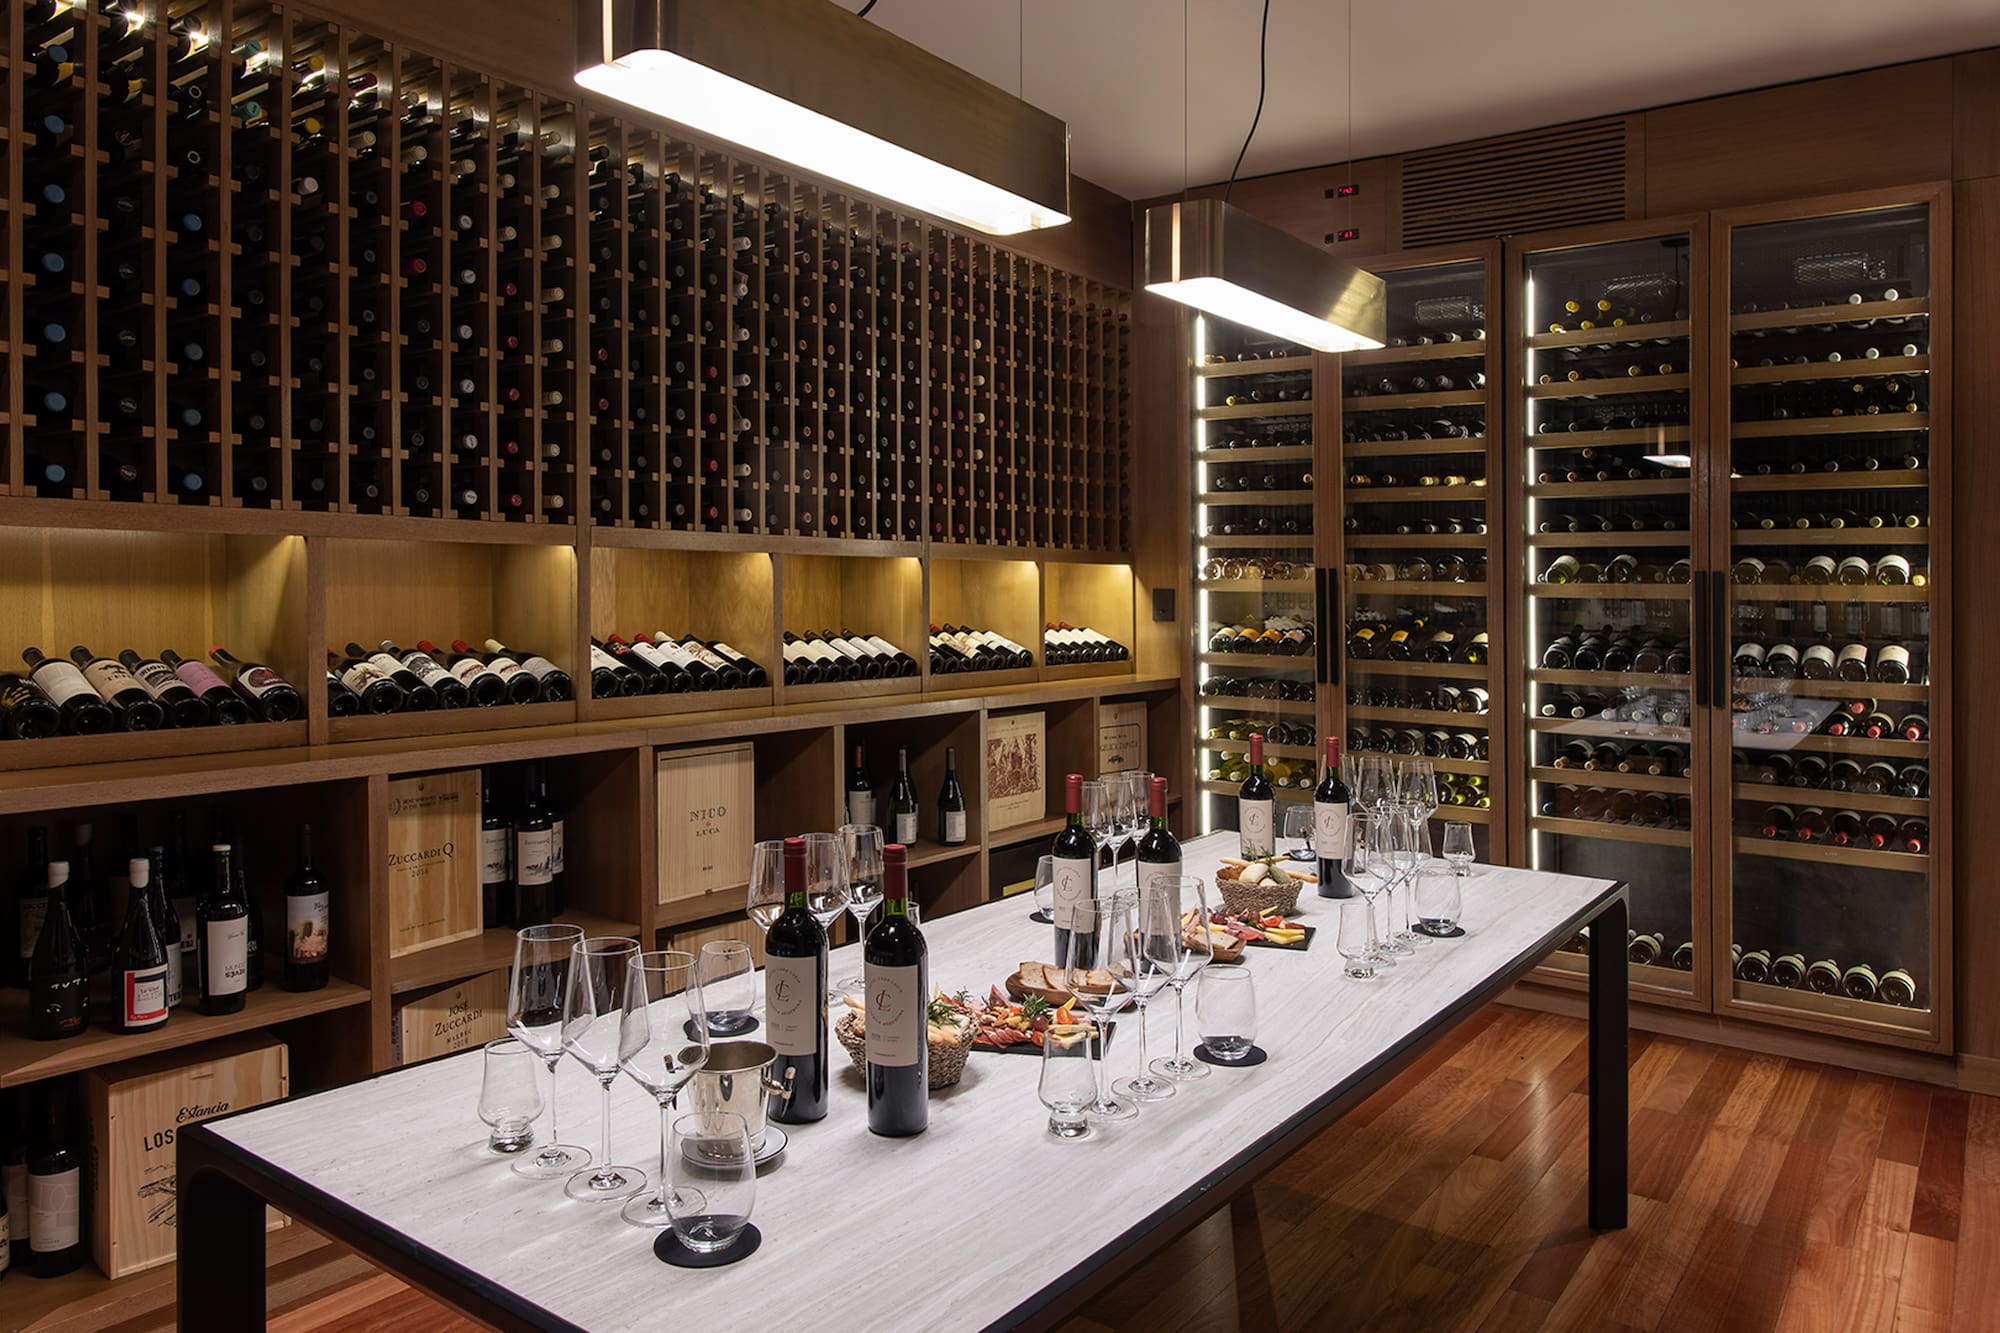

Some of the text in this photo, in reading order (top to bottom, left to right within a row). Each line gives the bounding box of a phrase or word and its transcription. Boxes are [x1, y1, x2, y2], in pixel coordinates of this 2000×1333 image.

[690, 806, 727, 822] NICO
[696, 827, 721, 837] LUCA
[388, 847, 441, 866] ZUCCARDI
[442, 842, 454, 858] Q
[434, 1009, 483, 1036] ZUCCARDI
[176, 1101, 229, 1123] Estancia
[144, 1129, 174, 1151] LOS
